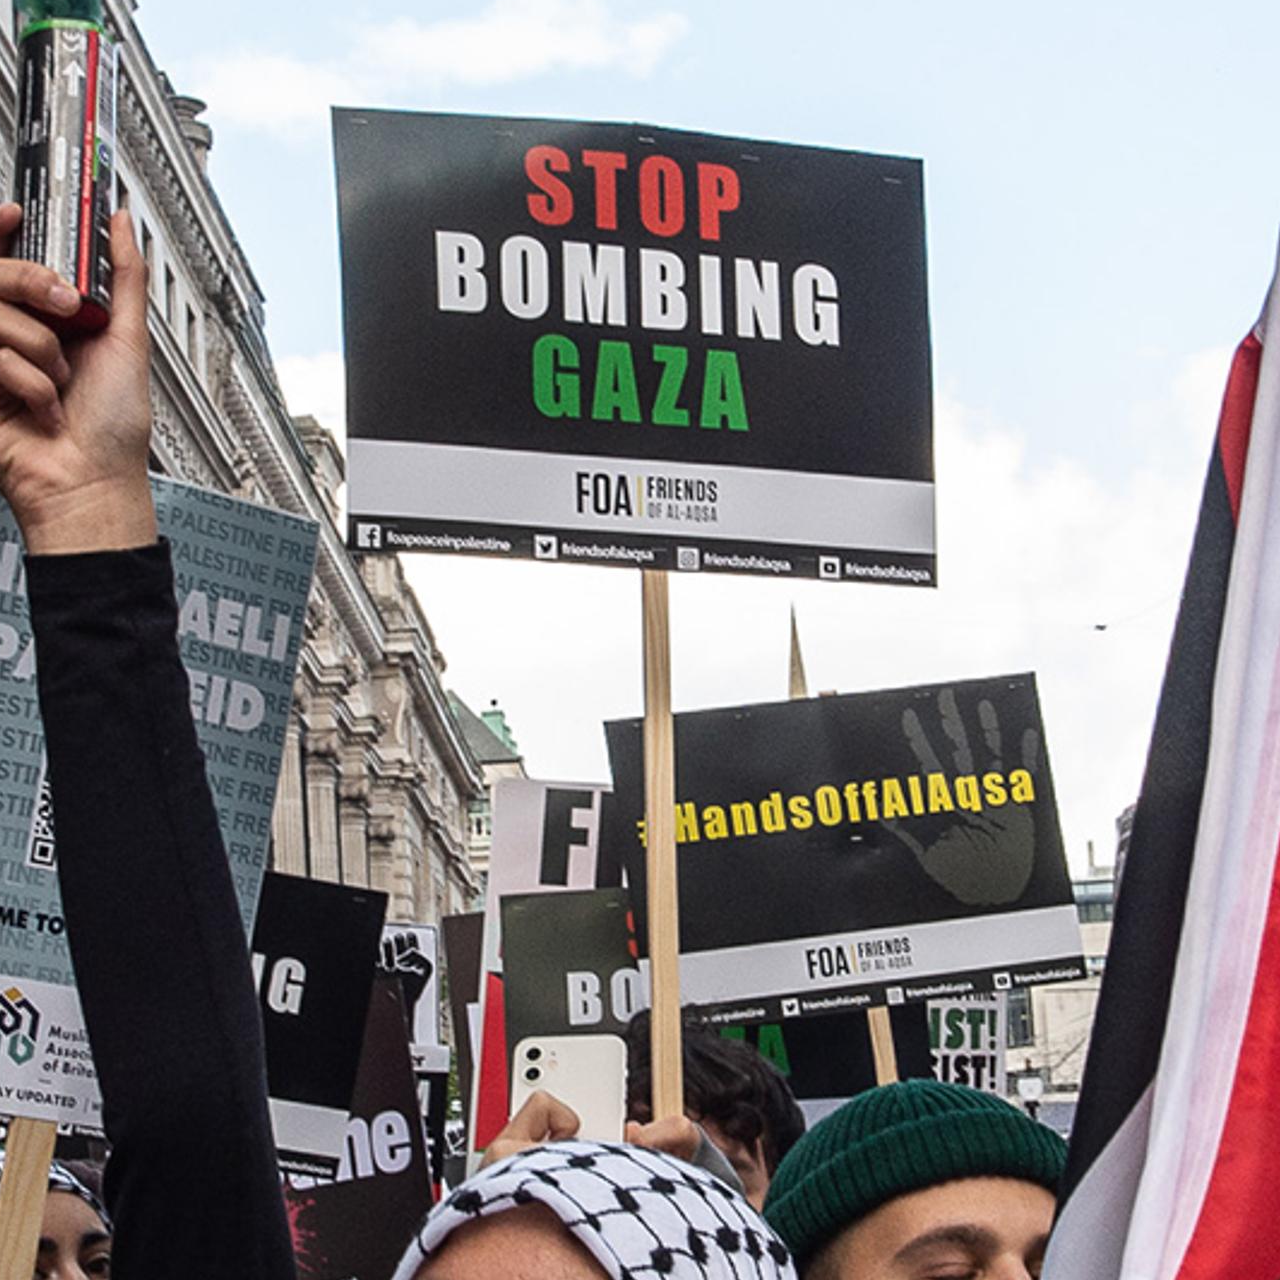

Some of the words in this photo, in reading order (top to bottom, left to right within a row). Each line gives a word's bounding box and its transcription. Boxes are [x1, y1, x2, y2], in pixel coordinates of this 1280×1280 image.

[524, 144, 741, 240] STOP
[434, 229, 842, 348] BOMBING
[530, 333, 751, 432] GAZA
[575, 471, 633, 517] FOA
[646, 475, 718, 504] FRIENDS
[35, 913, 66, 935] TO
[805, 944, 852, 980] FOA
[856, 937, 912, 958] FRIENDS
[16, 1088, 78, 1109] UPDATED
